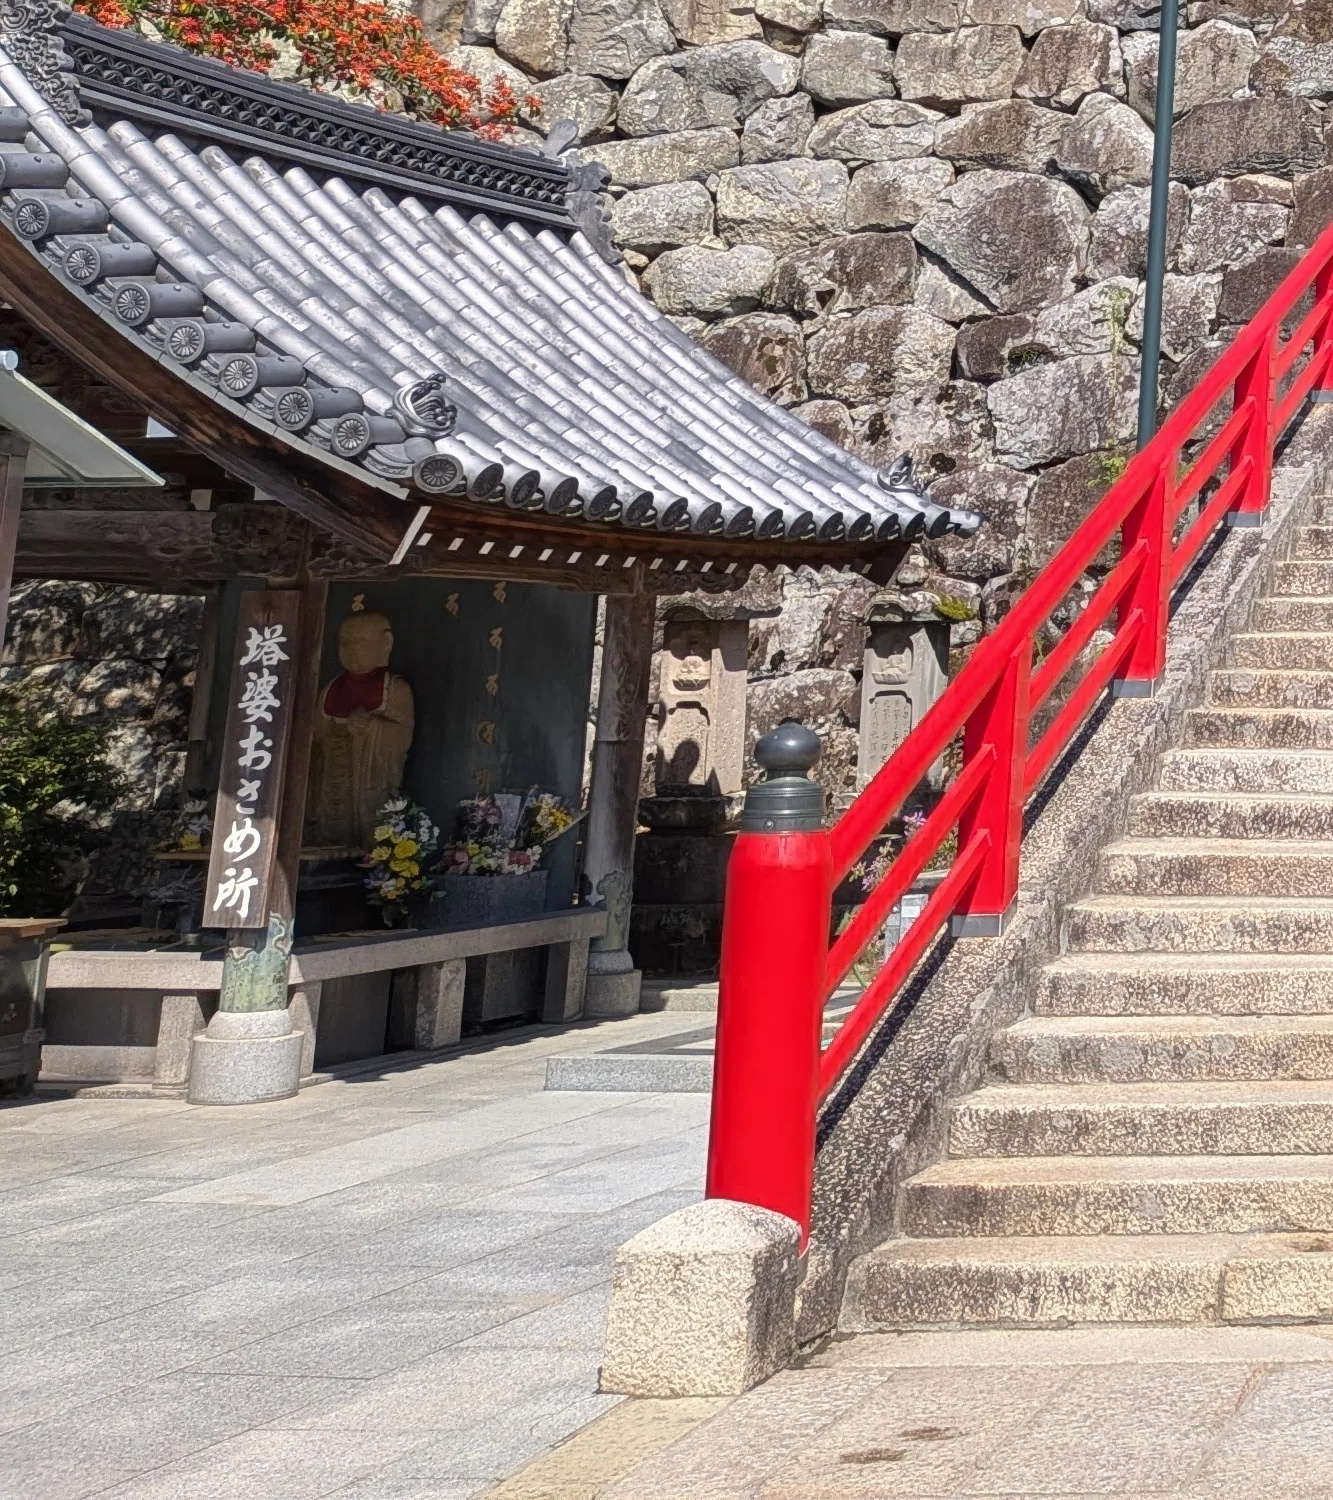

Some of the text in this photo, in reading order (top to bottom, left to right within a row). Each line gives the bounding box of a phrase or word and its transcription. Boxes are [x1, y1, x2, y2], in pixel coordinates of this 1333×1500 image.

[204, 624, 290, 919] 塔婆おさめ所
